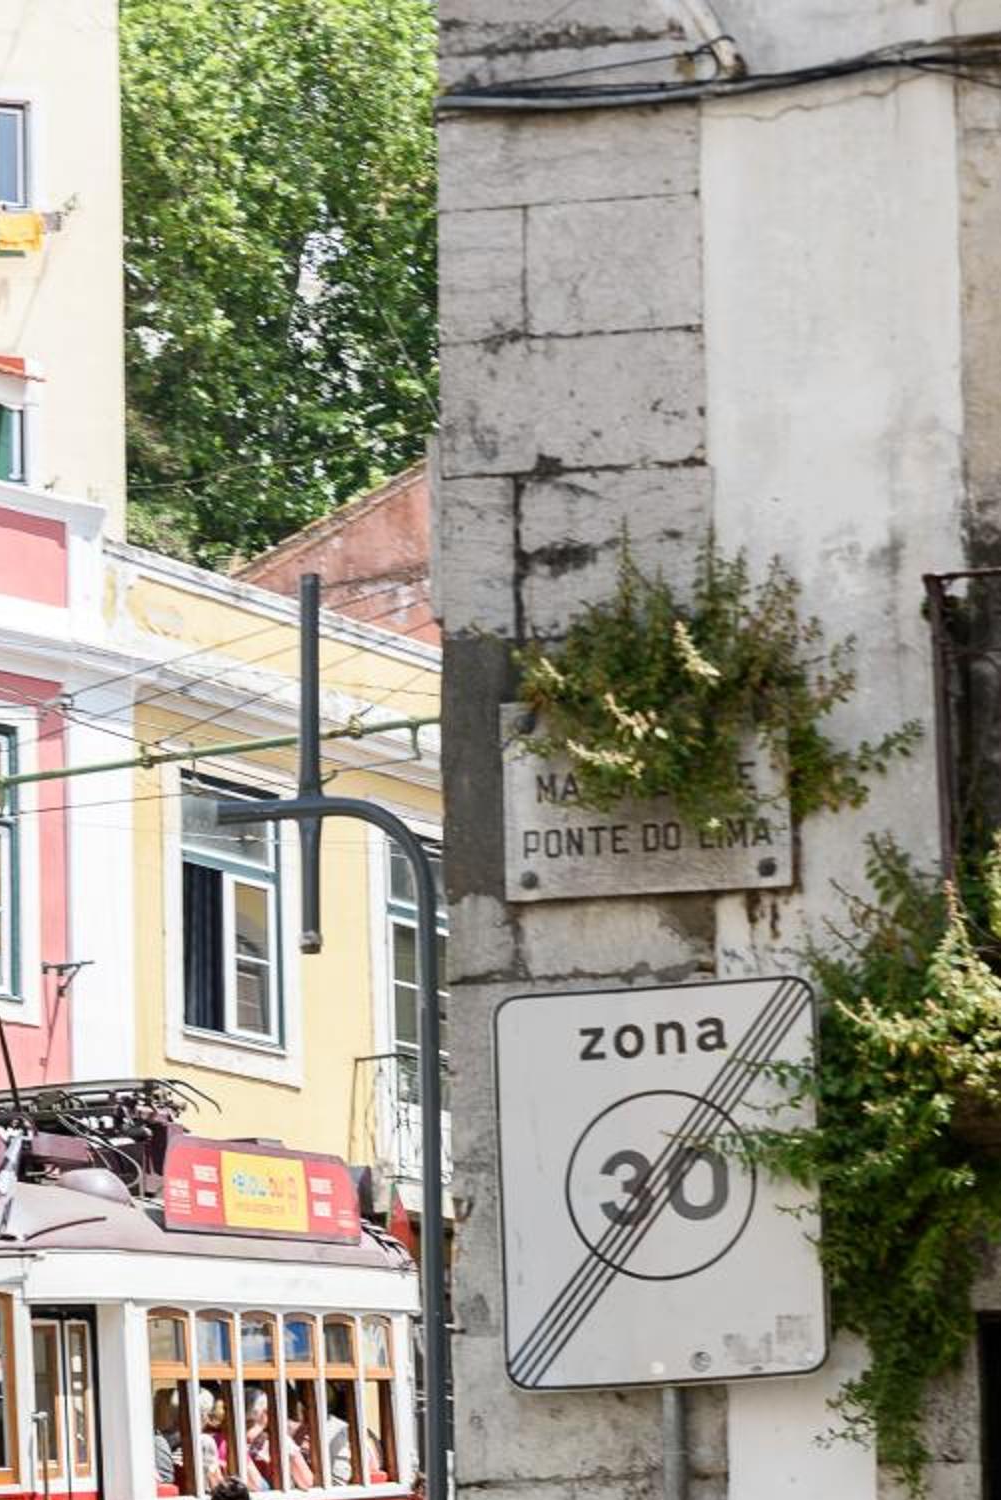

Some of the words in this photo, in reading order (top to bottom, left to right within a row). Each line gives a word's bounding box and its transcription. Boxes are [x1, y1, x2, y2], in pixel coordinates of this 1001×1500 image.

[523, 825, 629, 859] PONTE
[642, 823, 681, 853] DO
[578, 1016, 727, 1061] zona
[599, 1147, 730, 1227] 30
